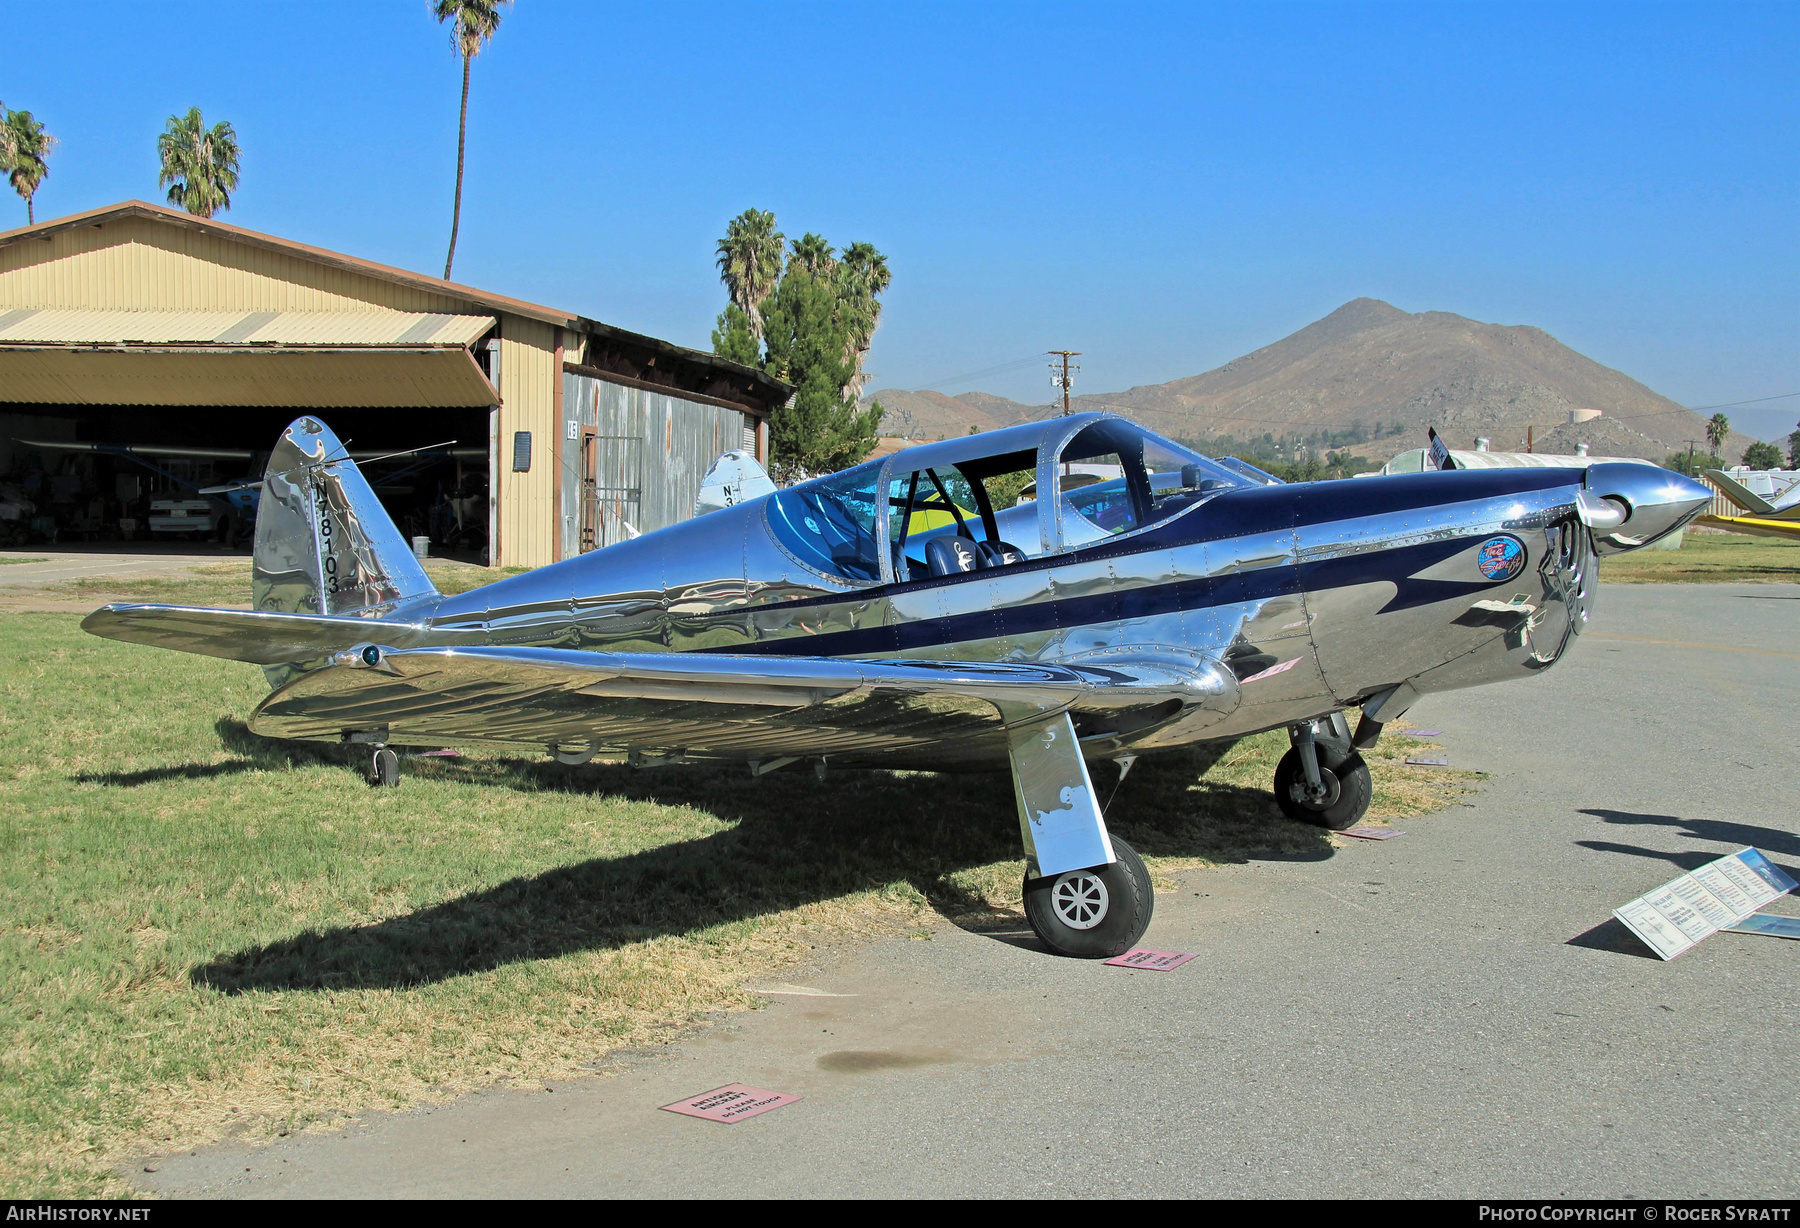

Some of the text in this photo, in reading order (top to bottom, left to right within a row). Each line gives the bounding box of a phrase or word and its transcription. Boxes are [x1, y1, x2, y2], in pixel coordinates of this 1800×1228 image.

[316, 480, 339, 594] N78103
[1484, 543, 1505, 557] The
[1480, 554, 1521, 575] Swift
[690, 1091, 737, 1107] ANTIQUE
[699, 1092, 748, 1110] AIRCRAFT
[725, 1098, 758, 1111] PLEASE
[735, 1105, 753, 1114] NOT
[752, 1095, 783, 1106] TOUCH
